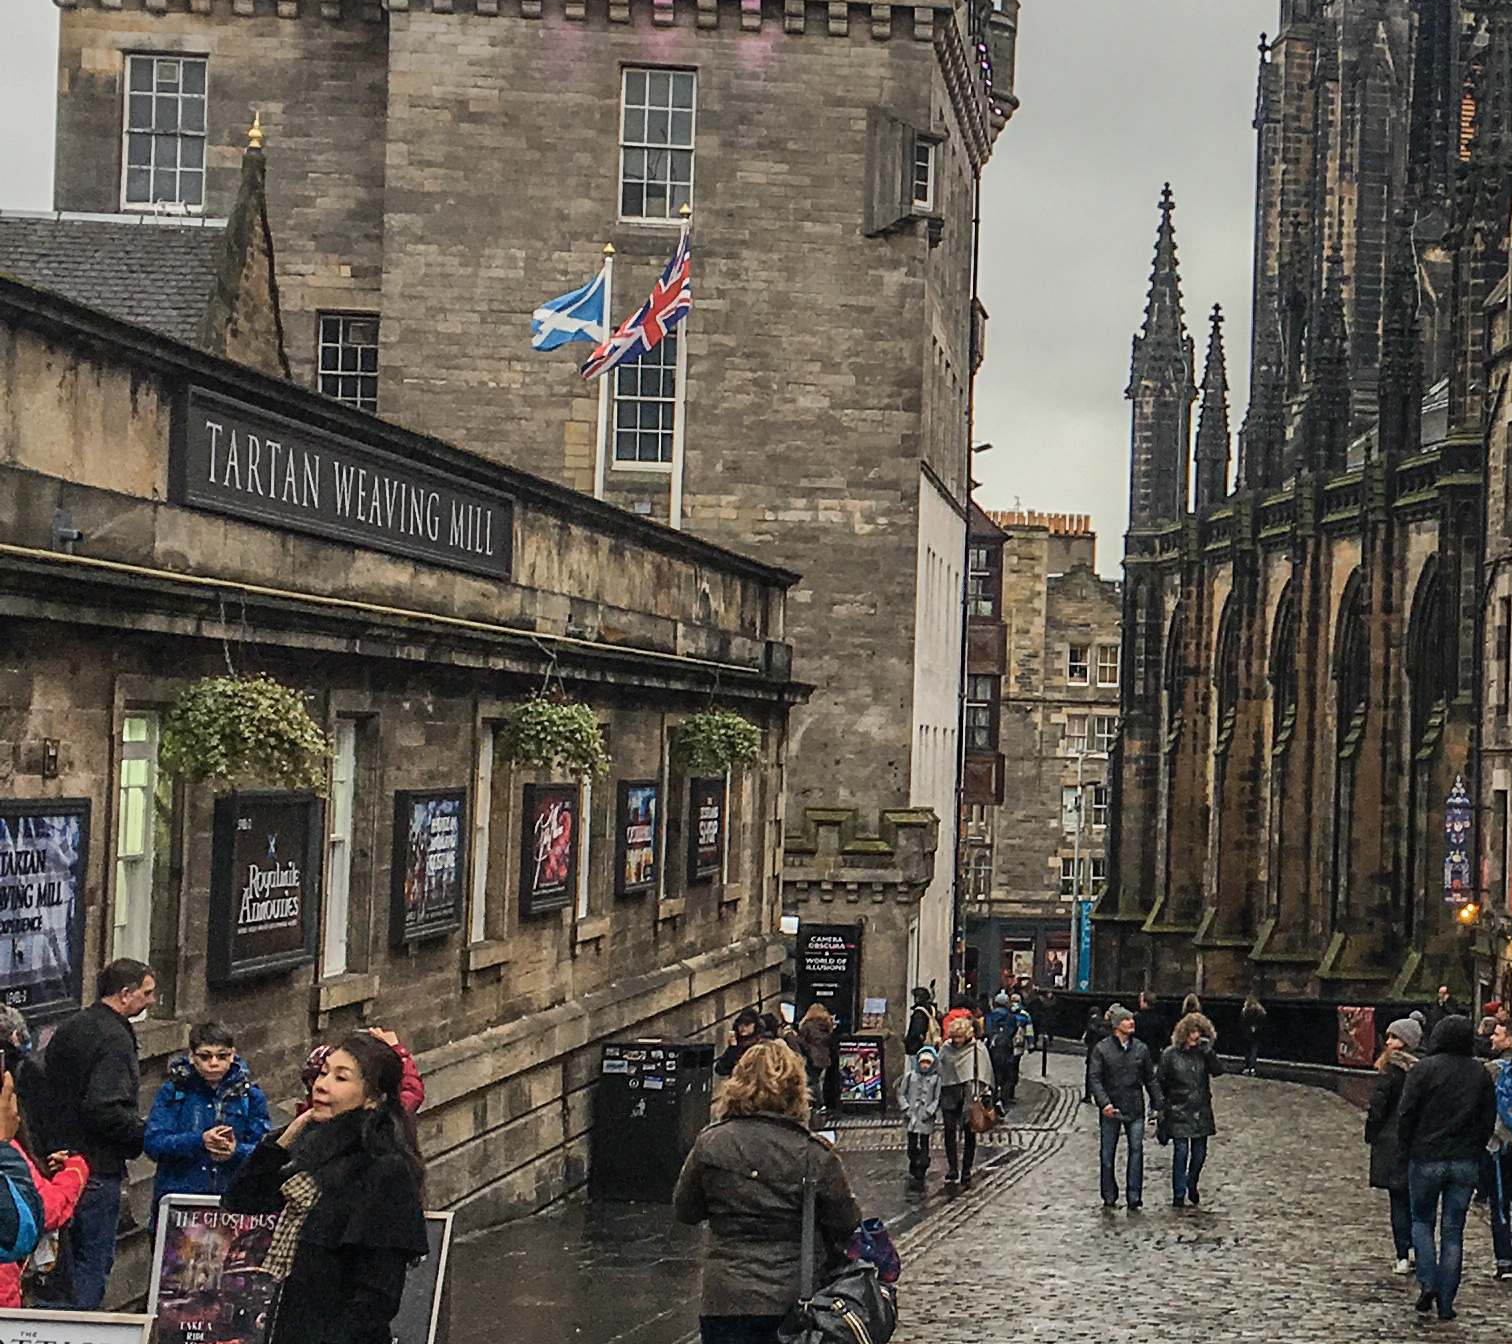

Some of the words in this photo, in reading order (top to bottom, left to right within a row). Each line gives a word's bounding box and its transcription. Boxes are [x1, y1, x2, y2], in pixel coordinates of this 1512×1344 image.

[206, 421, 320, 509] TARTAN
[333, 461, 440, 541] WEAVING
[449, 500, 493, 556] MILL
[36, 881, 63, 908] MILL
[176, 1211, 201, 1228] THE
[204, 1212, 244, 1230] GHOST
[249, 1213, 277, 1231] BUS
[20, 1330, 38, 1338] THE
[180, 1321, 204, 1331] TAKE
[207, 1322, 213, 1331] A
